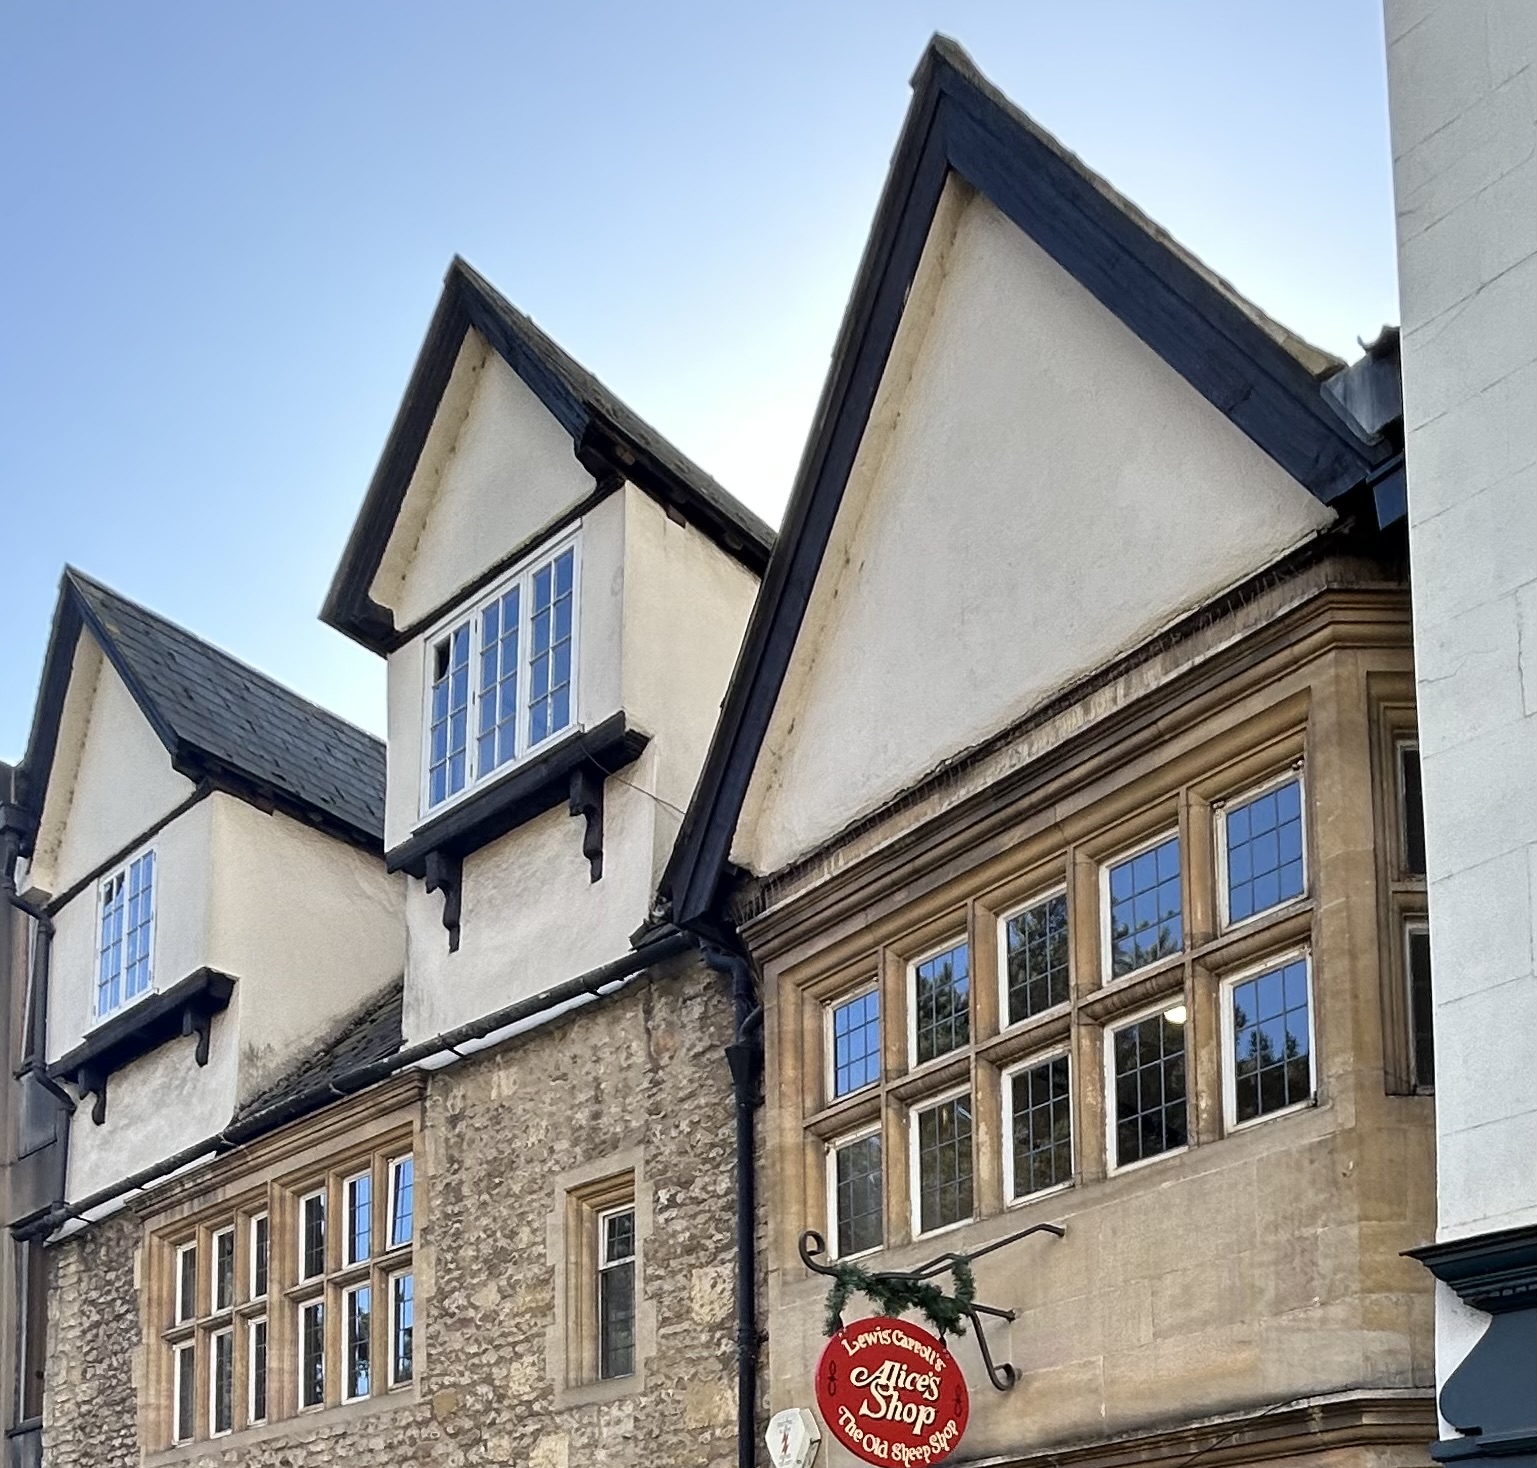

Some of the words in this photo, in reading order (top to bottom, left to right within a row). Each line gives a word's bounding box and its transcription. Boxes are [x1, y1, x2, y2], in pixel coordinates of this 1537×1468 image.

[841, 1326, 892, 1357] Lewis
[892, 1329, 947, 1372] Carroll's
[850, 1360, 941, 1400] Alice's
[859, 1379, 937, 1435] Shop
[838, 1405, 864, 1442] The
[862, 1433, 889, 1459] Old
[891, 1442, 931, 1468] Sheep
[929, 1419, 959, 1452] Shop
